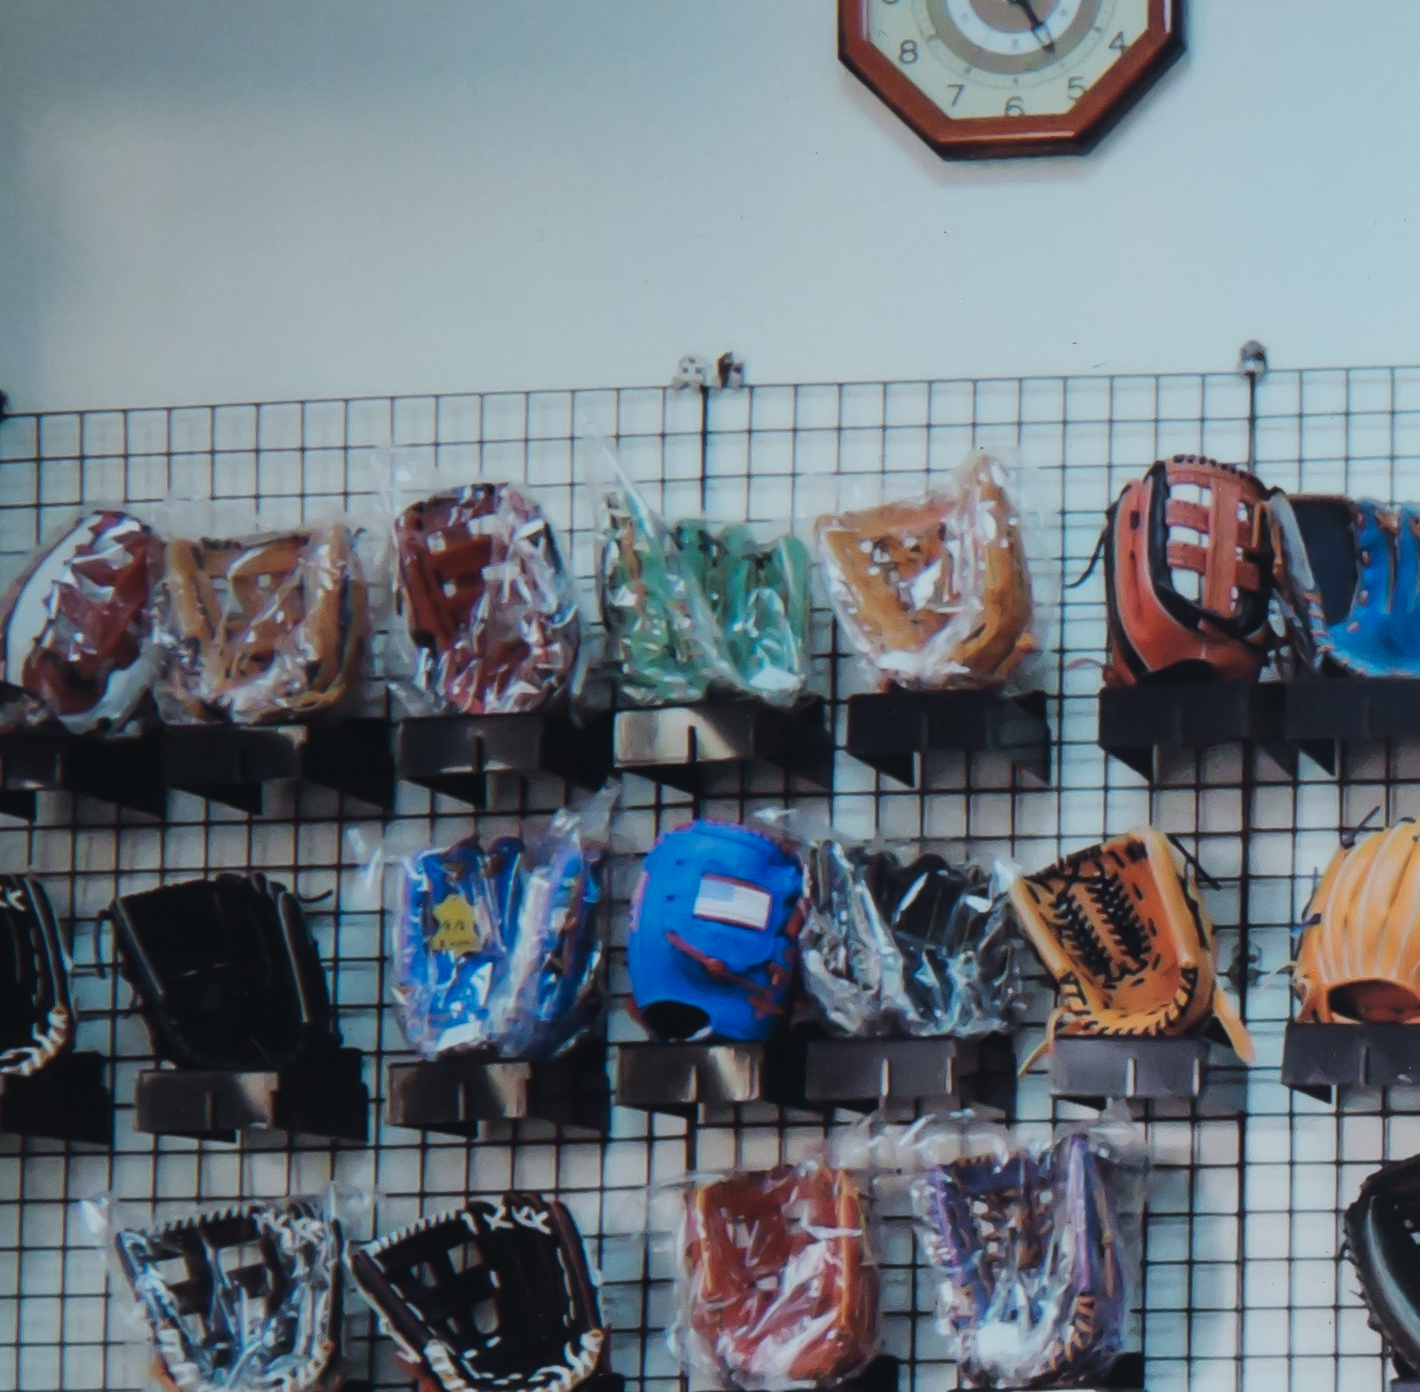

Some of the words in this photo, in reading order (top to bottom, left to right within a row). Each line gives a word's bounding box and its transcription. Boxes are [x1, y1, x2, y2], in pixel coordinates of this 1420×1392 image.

[899, 39, 917, 64] 8
[1108, 30, 1128, 54] 4
[946, 84, 965, 107] 7
[1067, 76, 1086, 100] 5
[1004, 95, 1024, 116] 6
